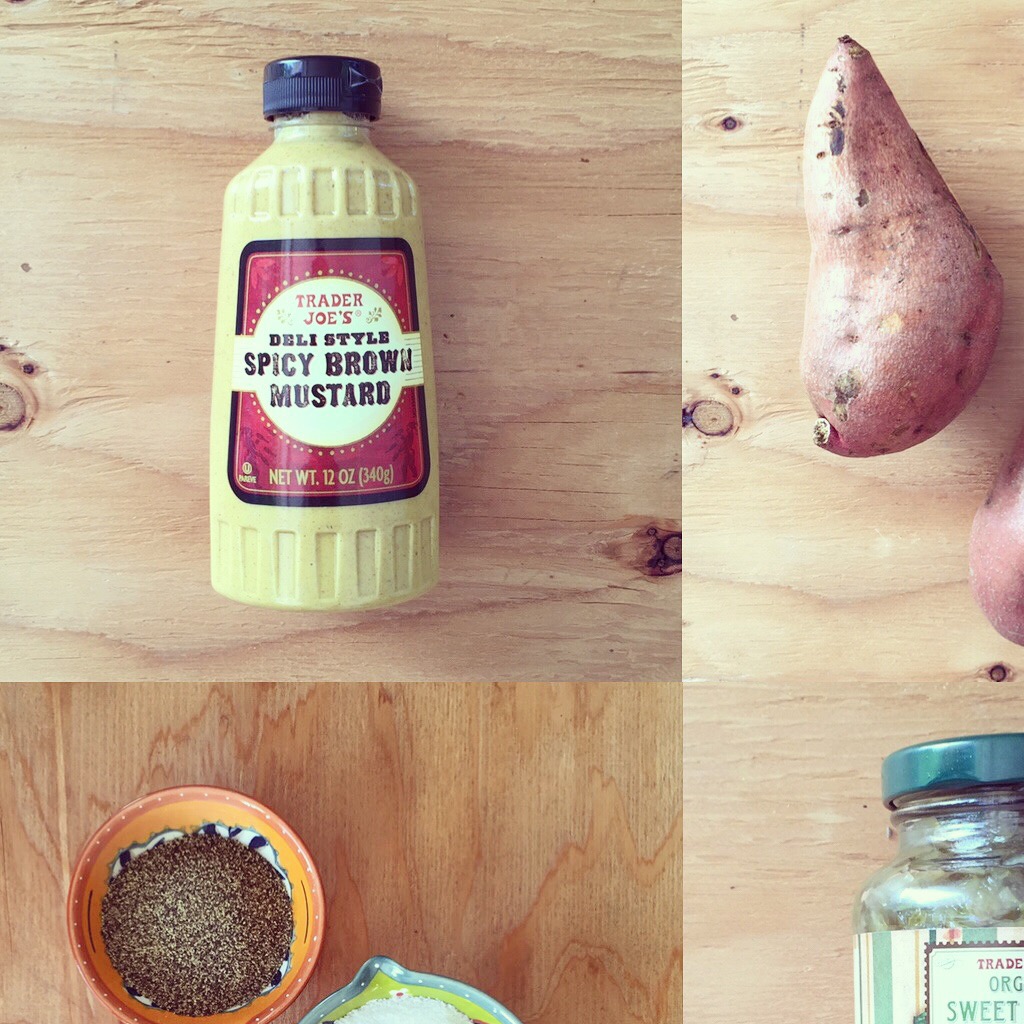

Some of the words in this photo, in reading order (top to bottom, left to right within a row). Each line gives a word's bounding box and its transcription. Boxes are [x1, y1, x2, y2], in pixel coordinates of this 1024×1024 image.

[296, 294, 363, 308] TRADER
[269, 333, 317, 347] DELI
[324, 331, 390, 345] STYLE
[244, 352, 314, 377] SPICY
[325, 348, 413, 376] BROWN
[270, 380, 391, 409] MUSTARD
[269, 468, 292, 486] NET
[295, 469, 319, 486] WT.
[323, 469, 336, 485] 12
[338, 468, 356, 485] OZ
[359, 464, 394, 487] (340g)
[946, 1000, 1022, 1022] SWEET
